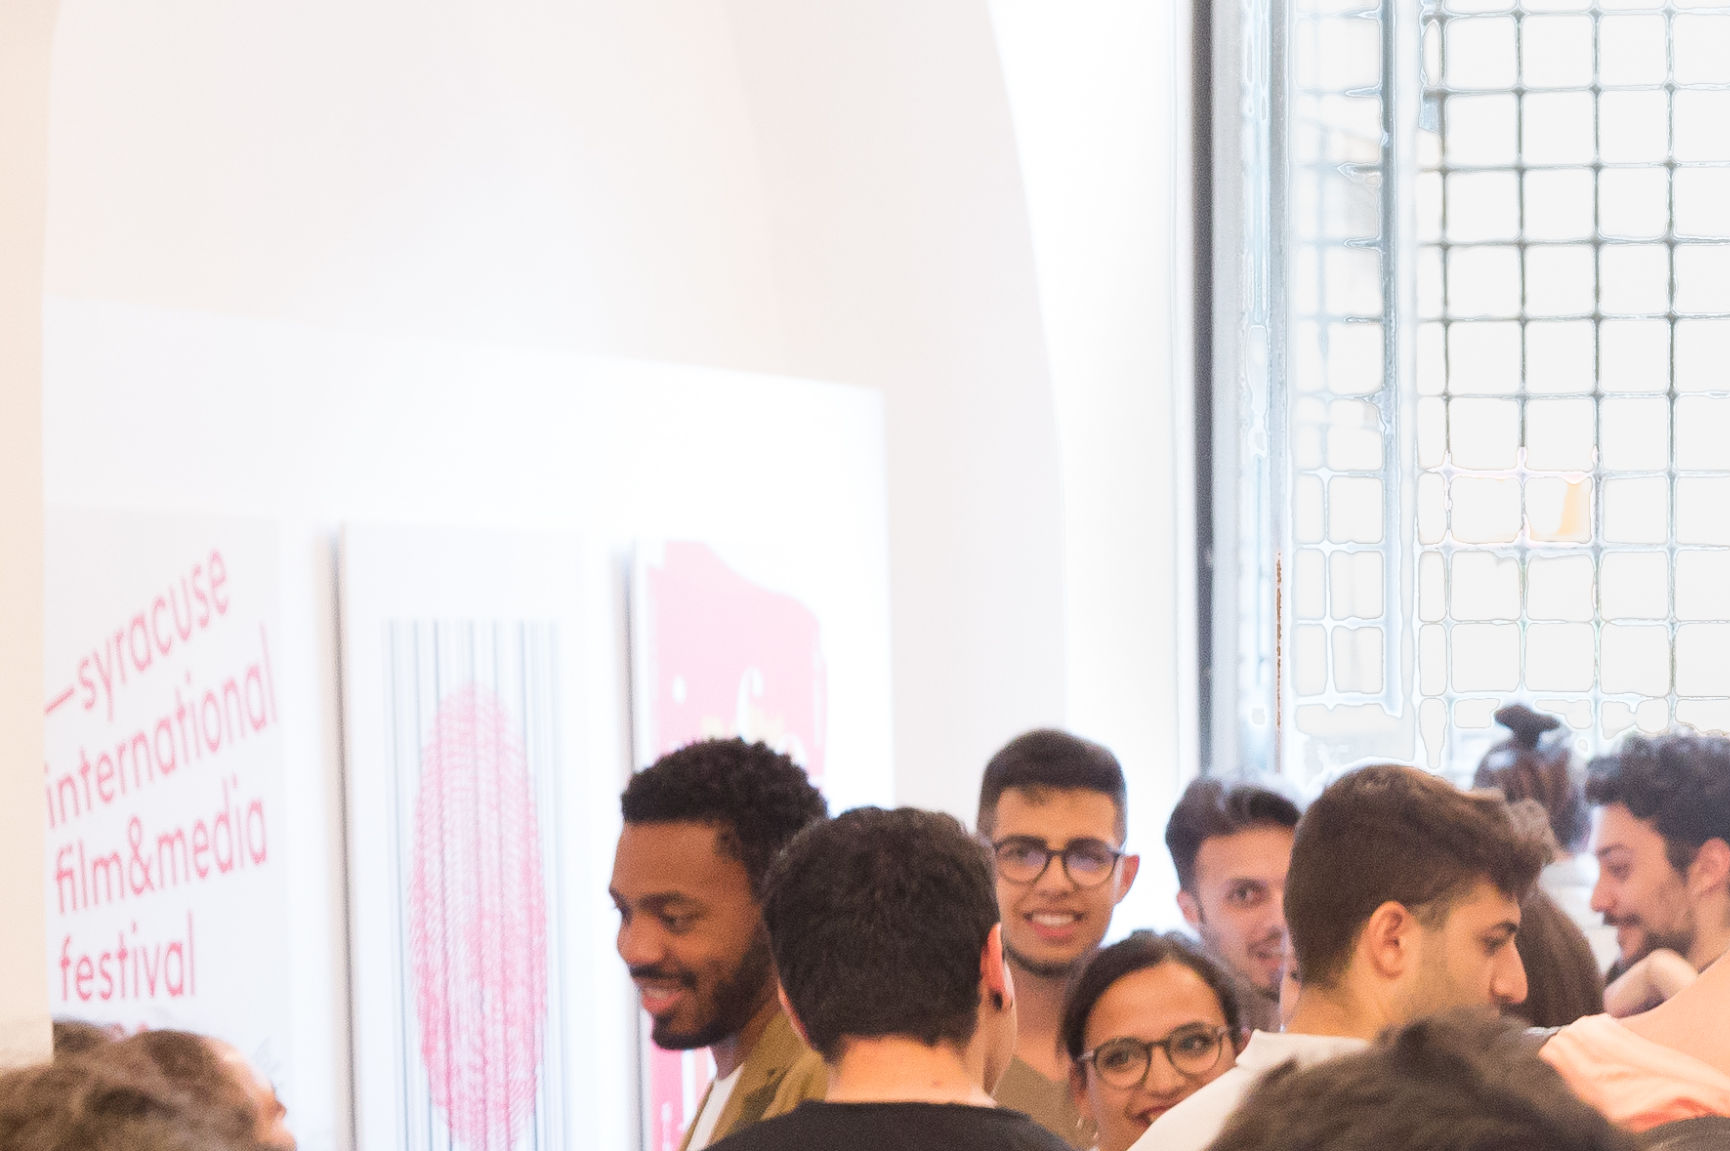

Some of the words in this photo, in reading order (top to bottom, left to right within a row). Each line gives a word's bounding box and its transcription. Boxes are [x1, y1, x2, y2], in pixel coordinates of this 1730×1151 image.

[45, 620, 278, 829] international
[55, 772, 268, 915] film&media
[59, 908, 196, 1002] festival
